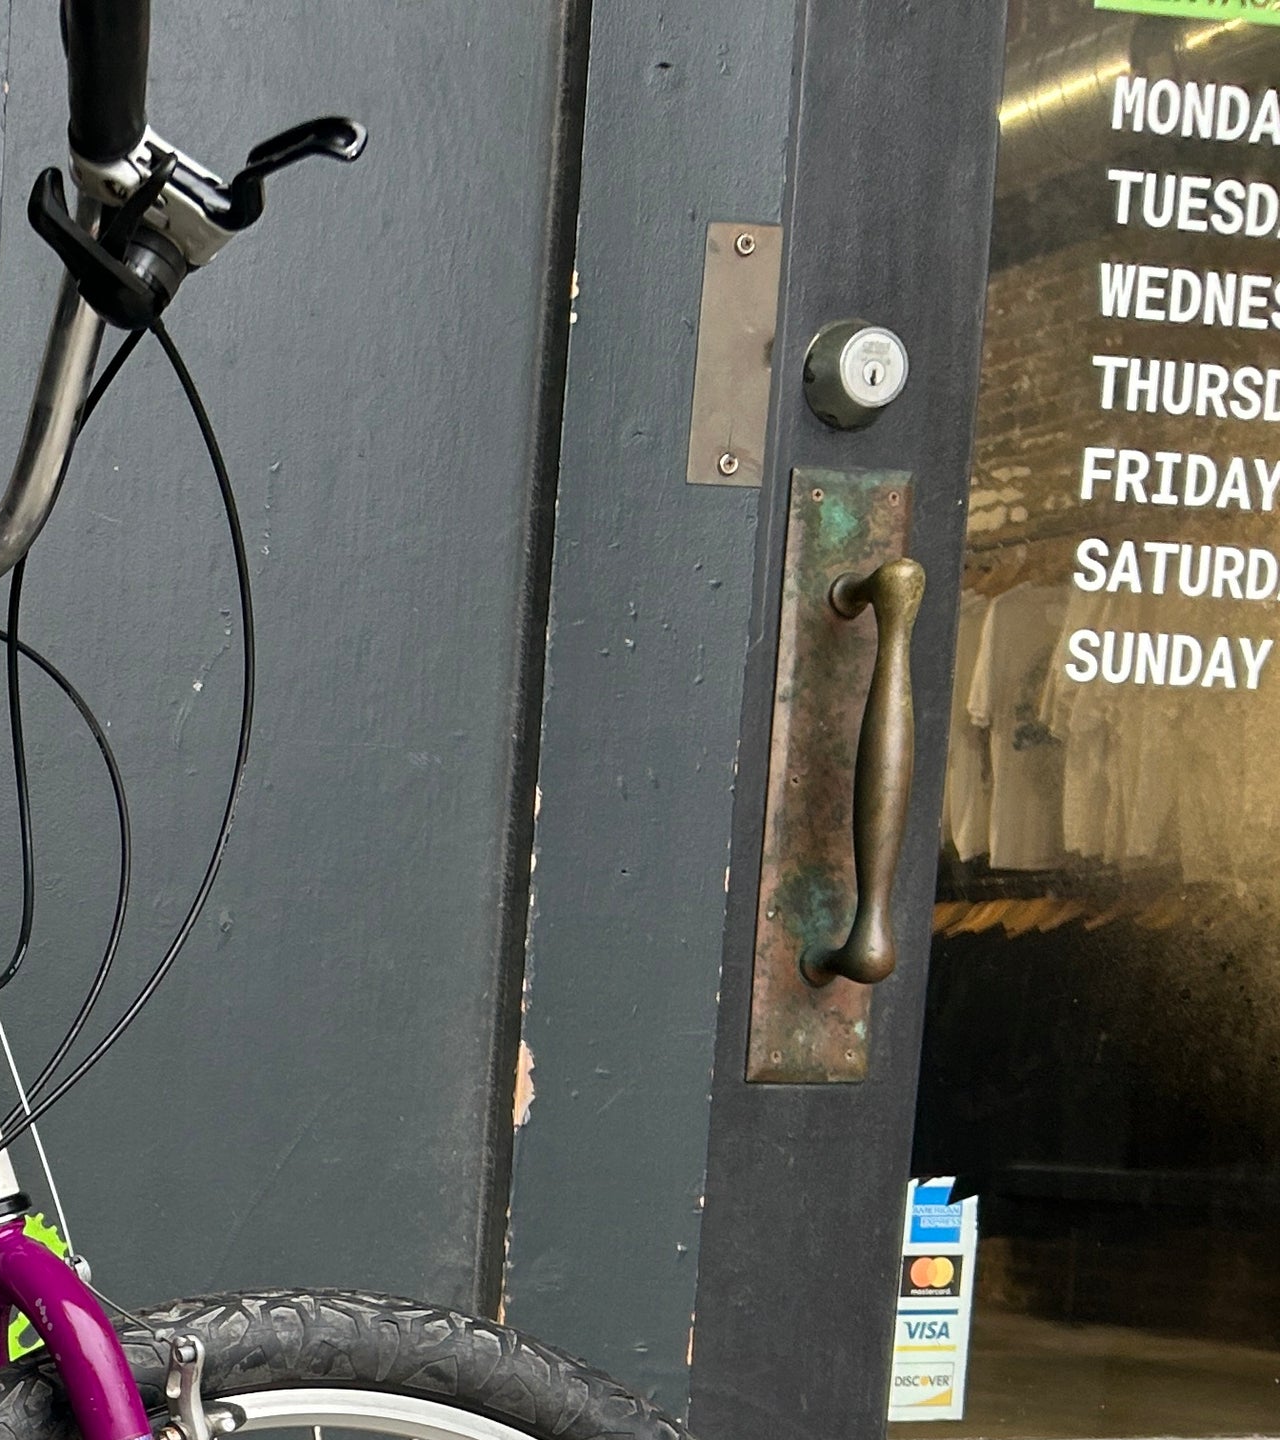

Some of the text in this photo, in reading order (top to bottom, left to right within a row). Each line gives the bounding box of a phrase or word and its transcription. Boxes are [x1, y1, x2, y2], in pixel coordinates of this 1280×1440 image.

[1107, 168, 1280, 240] TUESD
[1100, 262, 1280, 332] WEDNE
[1080, 446, 1280, 512] FRIDAY
[1073, 537, 1280, 602] SATURD
[1064, 628, 1274, 691] SUNDAY
[904, 1321, 950, 1339] VISA
[894, 1374, 950, 1387] DISCOVER
